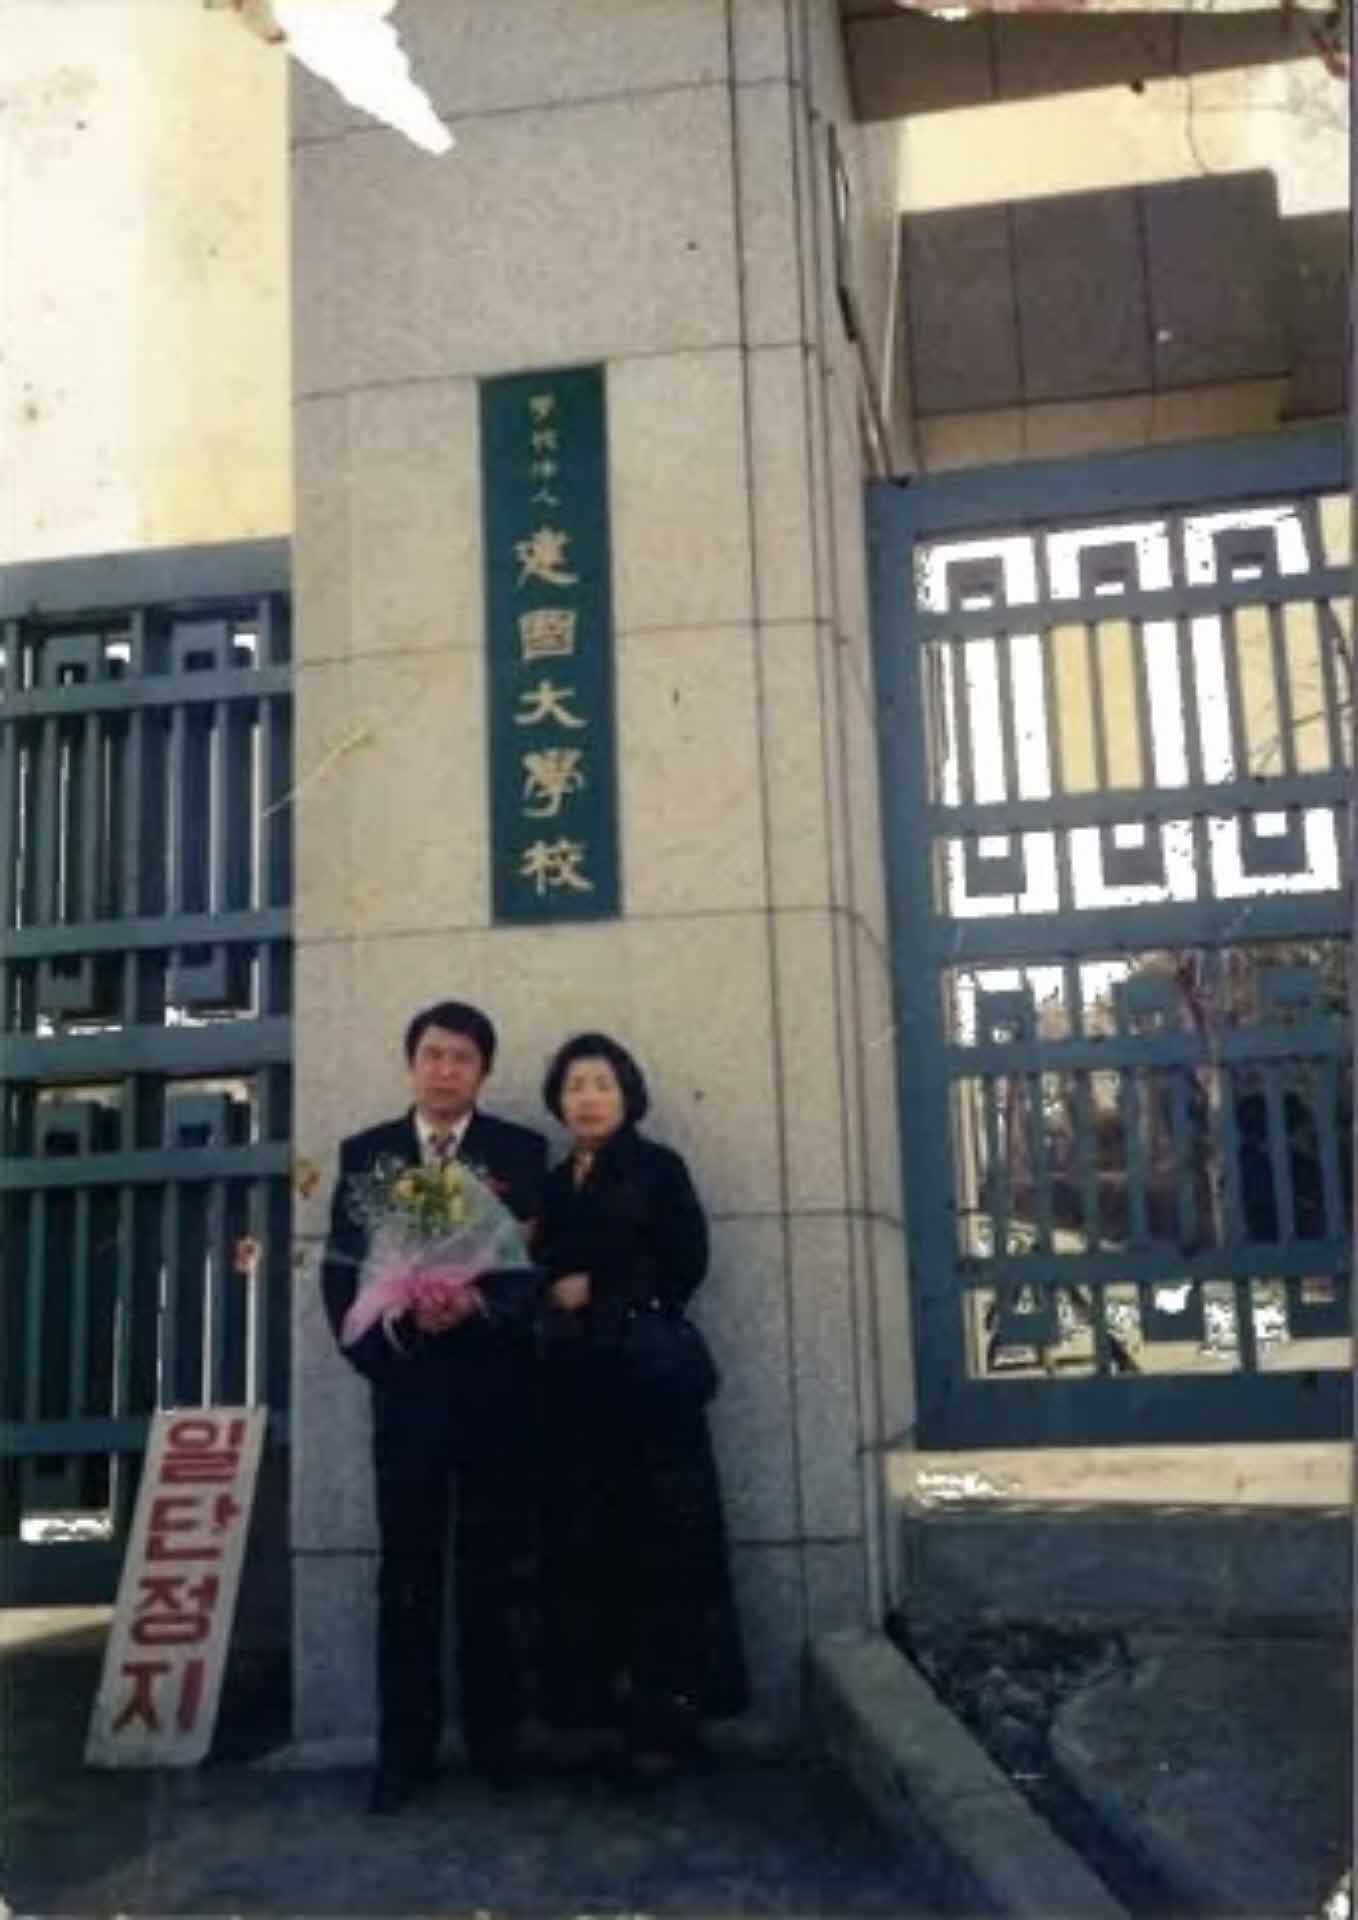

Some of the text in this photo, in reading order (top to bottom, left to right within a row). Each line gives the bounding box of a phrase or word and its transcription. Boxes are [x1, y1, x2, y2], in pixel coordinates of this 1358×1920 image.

[513, 525, 594, 896] 建國大學校
[112, 1419, 247, 1733] 일단정지
